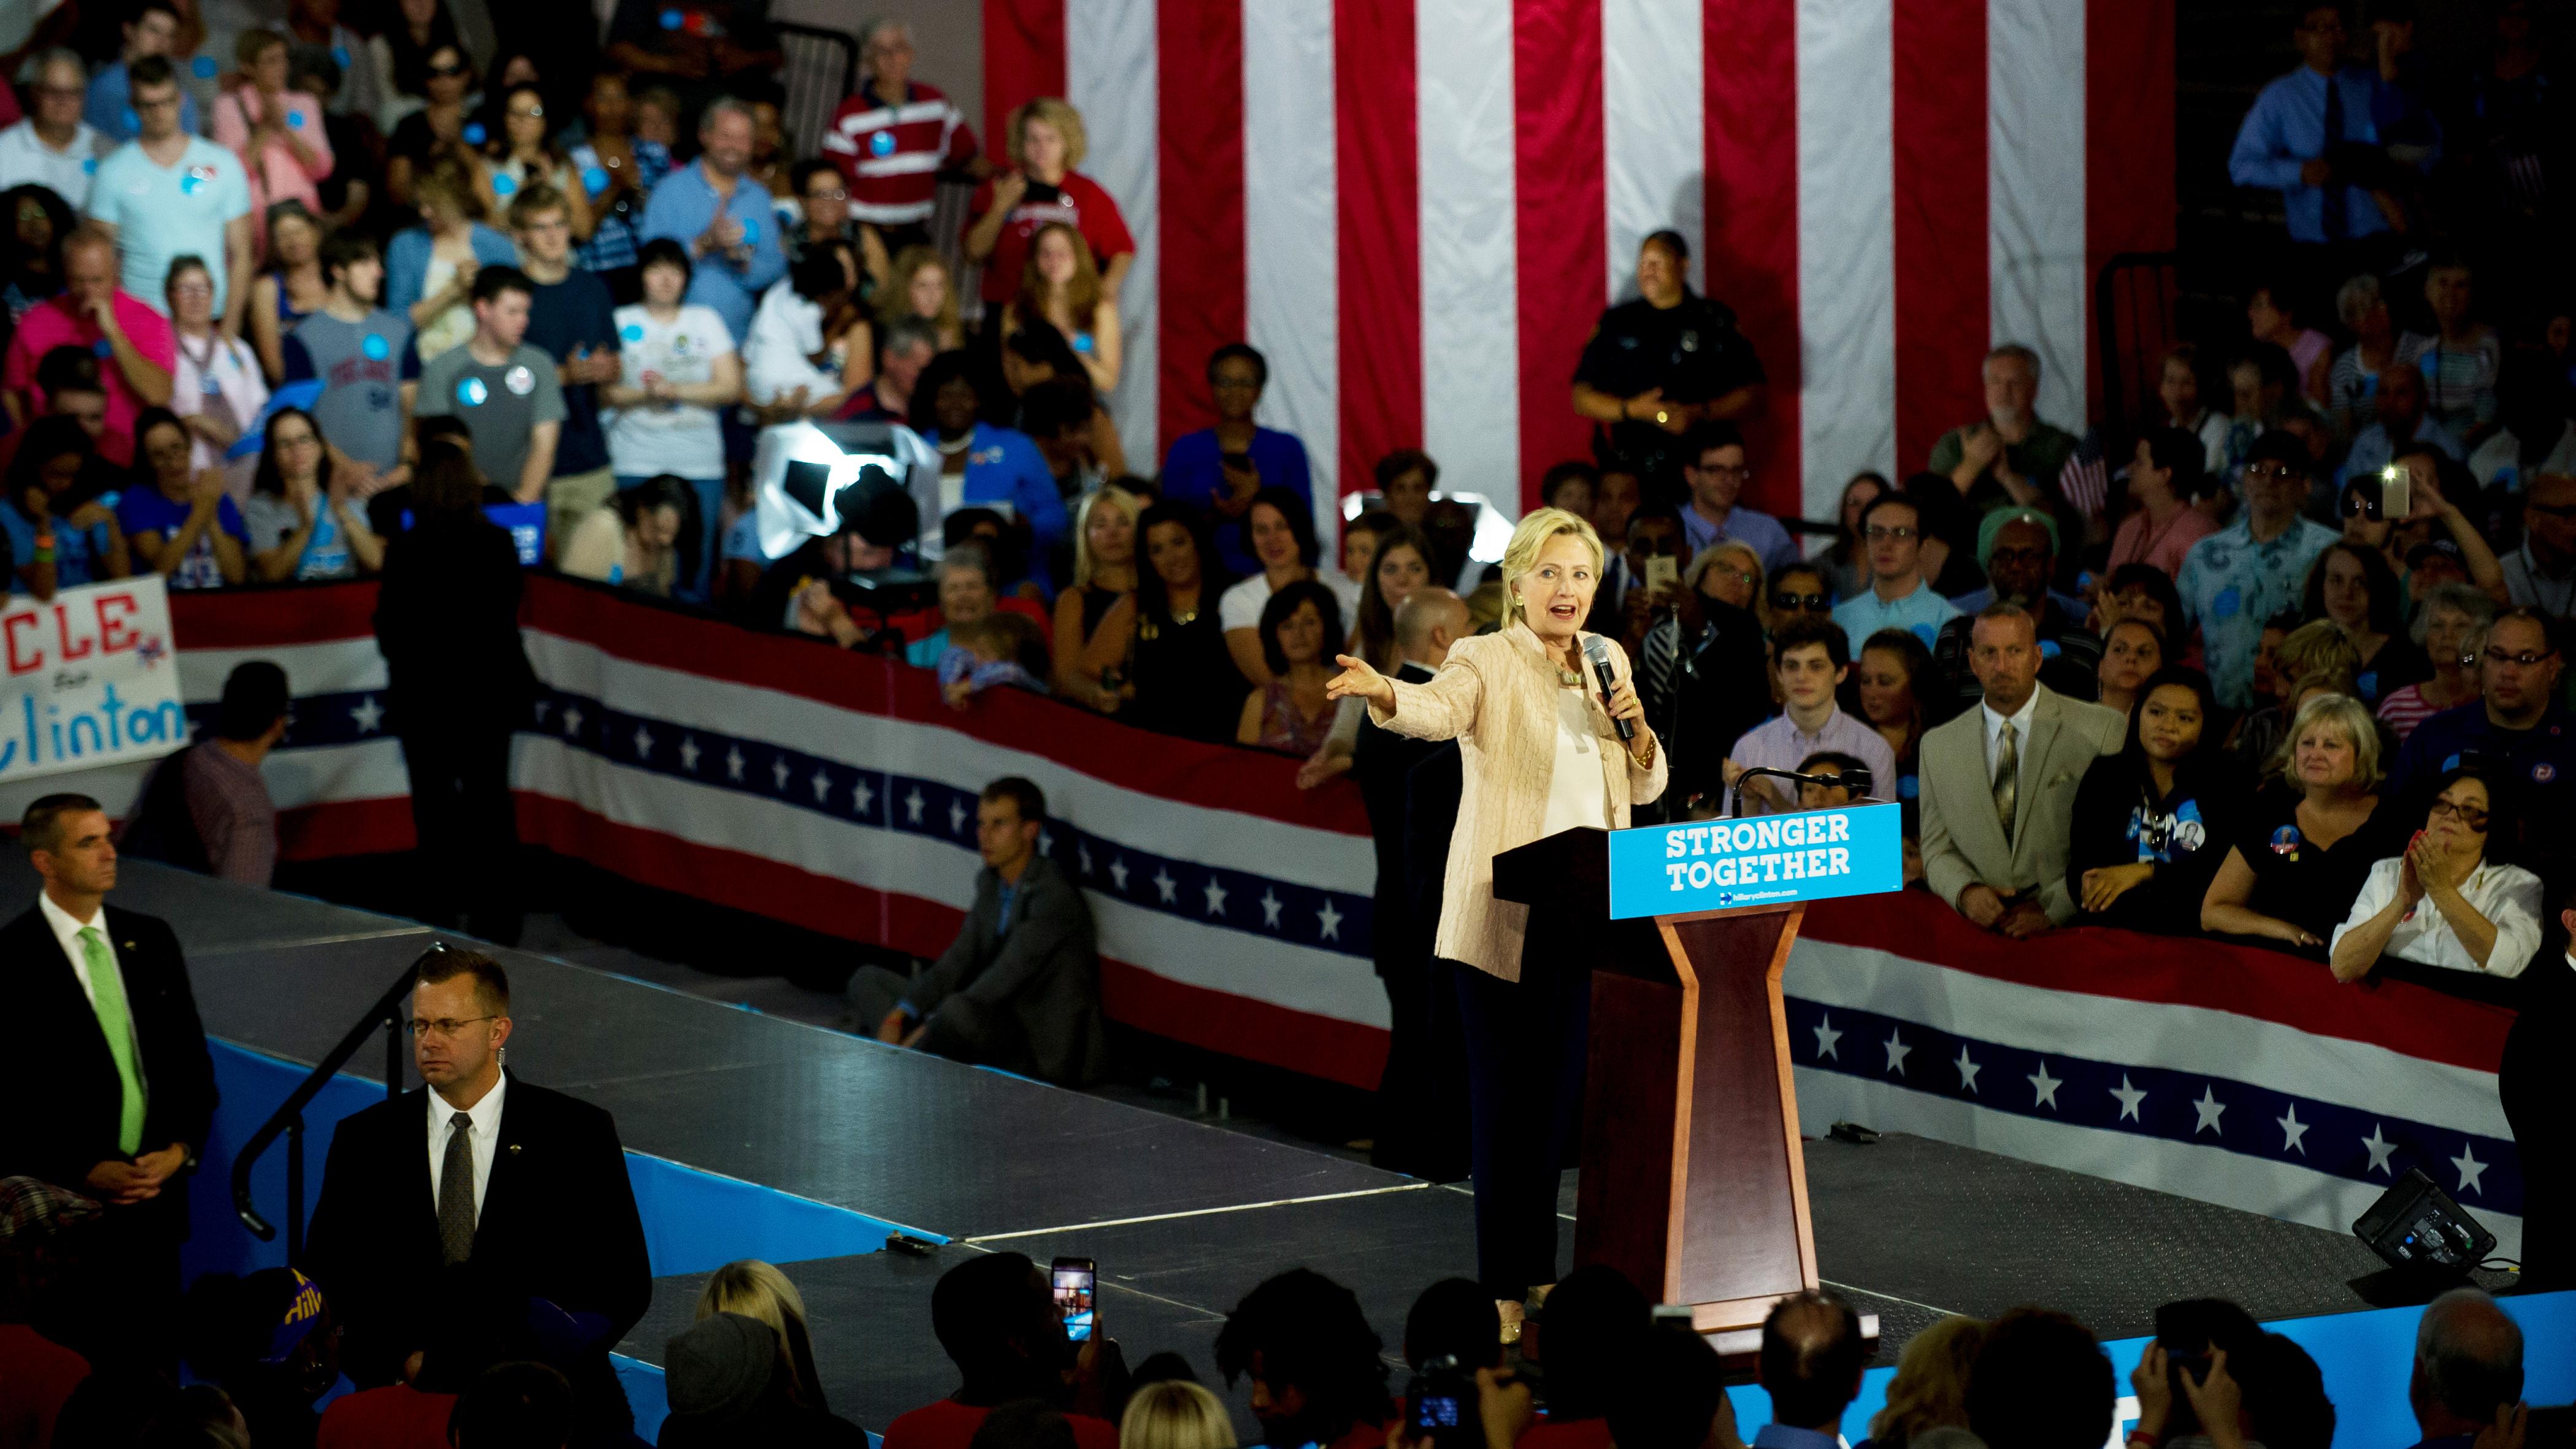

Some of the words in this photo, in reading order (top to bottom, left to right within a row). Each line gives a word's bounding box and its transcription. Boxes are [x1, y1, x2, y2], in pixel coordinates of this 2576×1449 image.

[1666, 814, 1849, 858] STRONGER
[1666, 847, 1850, 891] TOGETHER
[1733, 890, 1798, 901] hillaryclinton.com
